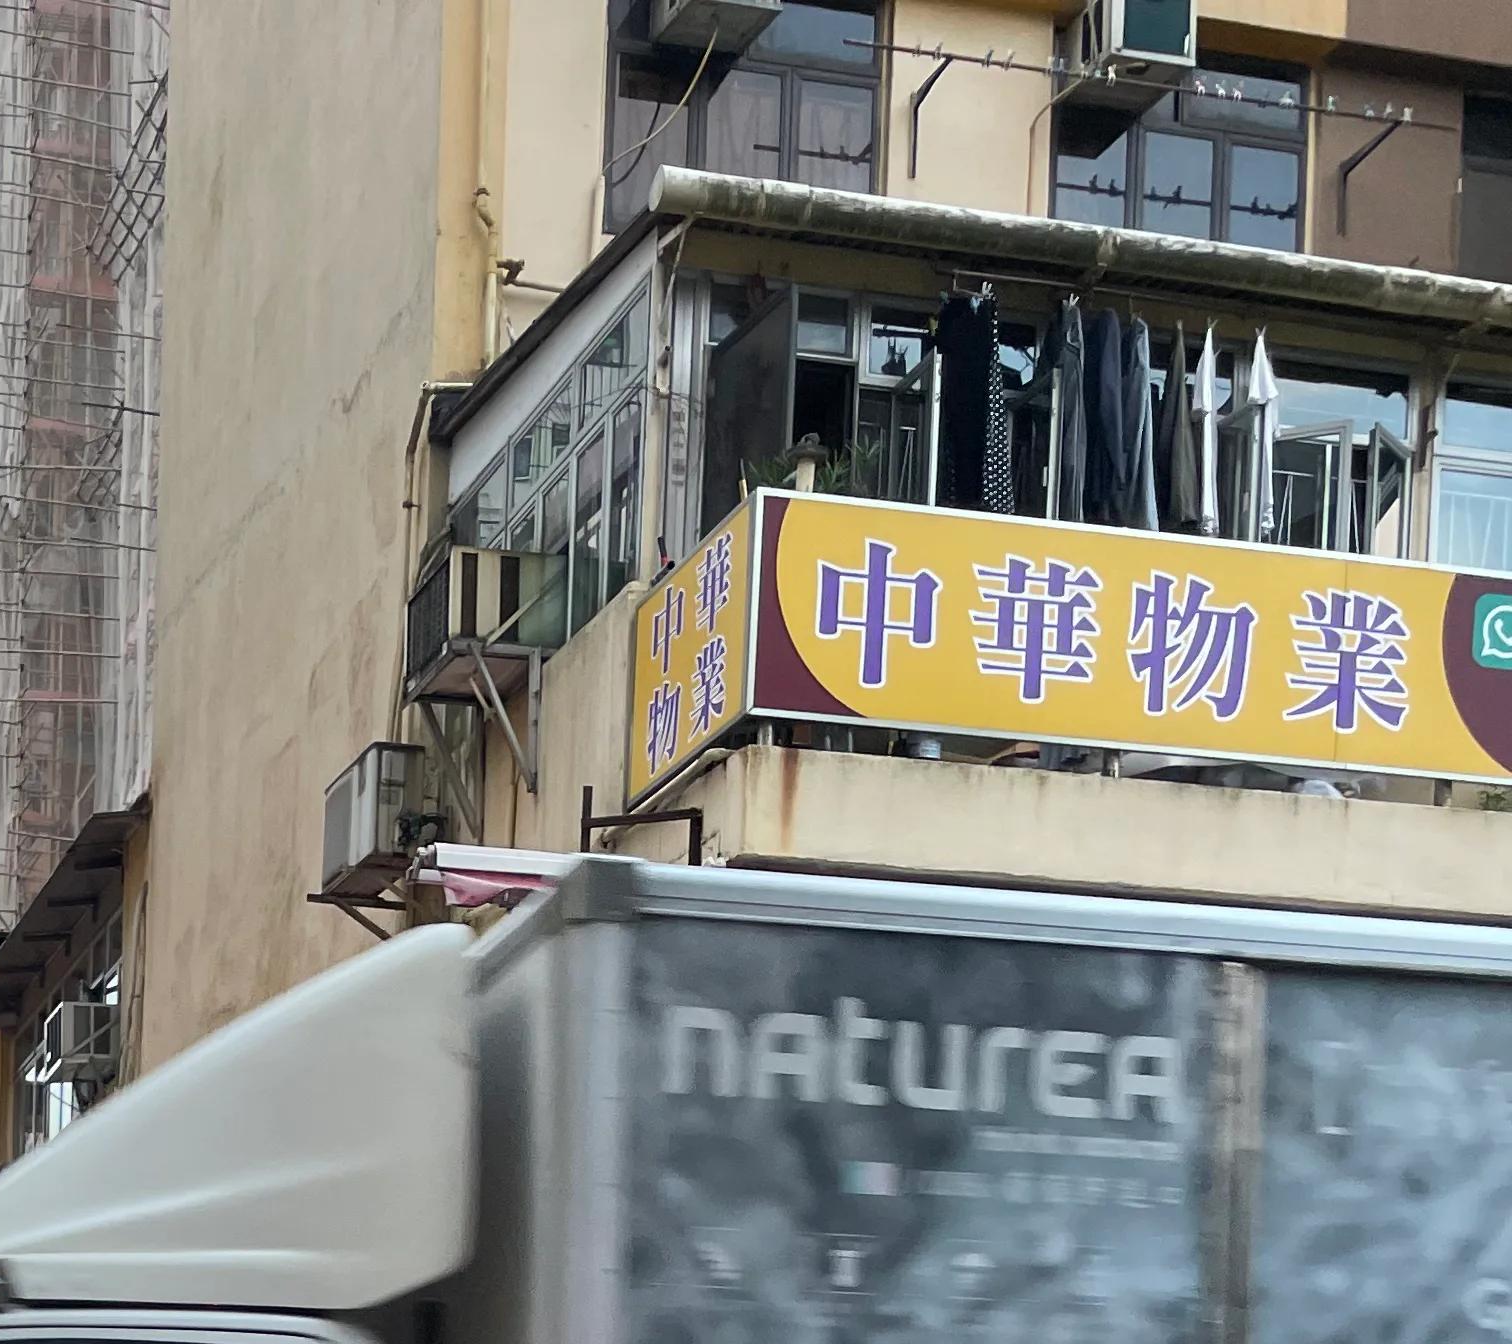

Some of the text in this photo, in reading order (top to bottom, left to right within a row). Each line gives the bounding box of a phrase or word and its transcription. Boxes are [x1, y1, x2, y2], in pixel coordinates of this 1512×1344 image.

[651, 532, 732, 672] 中華
[817, 537, 1411, 732] 中華物業
[646, 638, 725, 776] 物業
